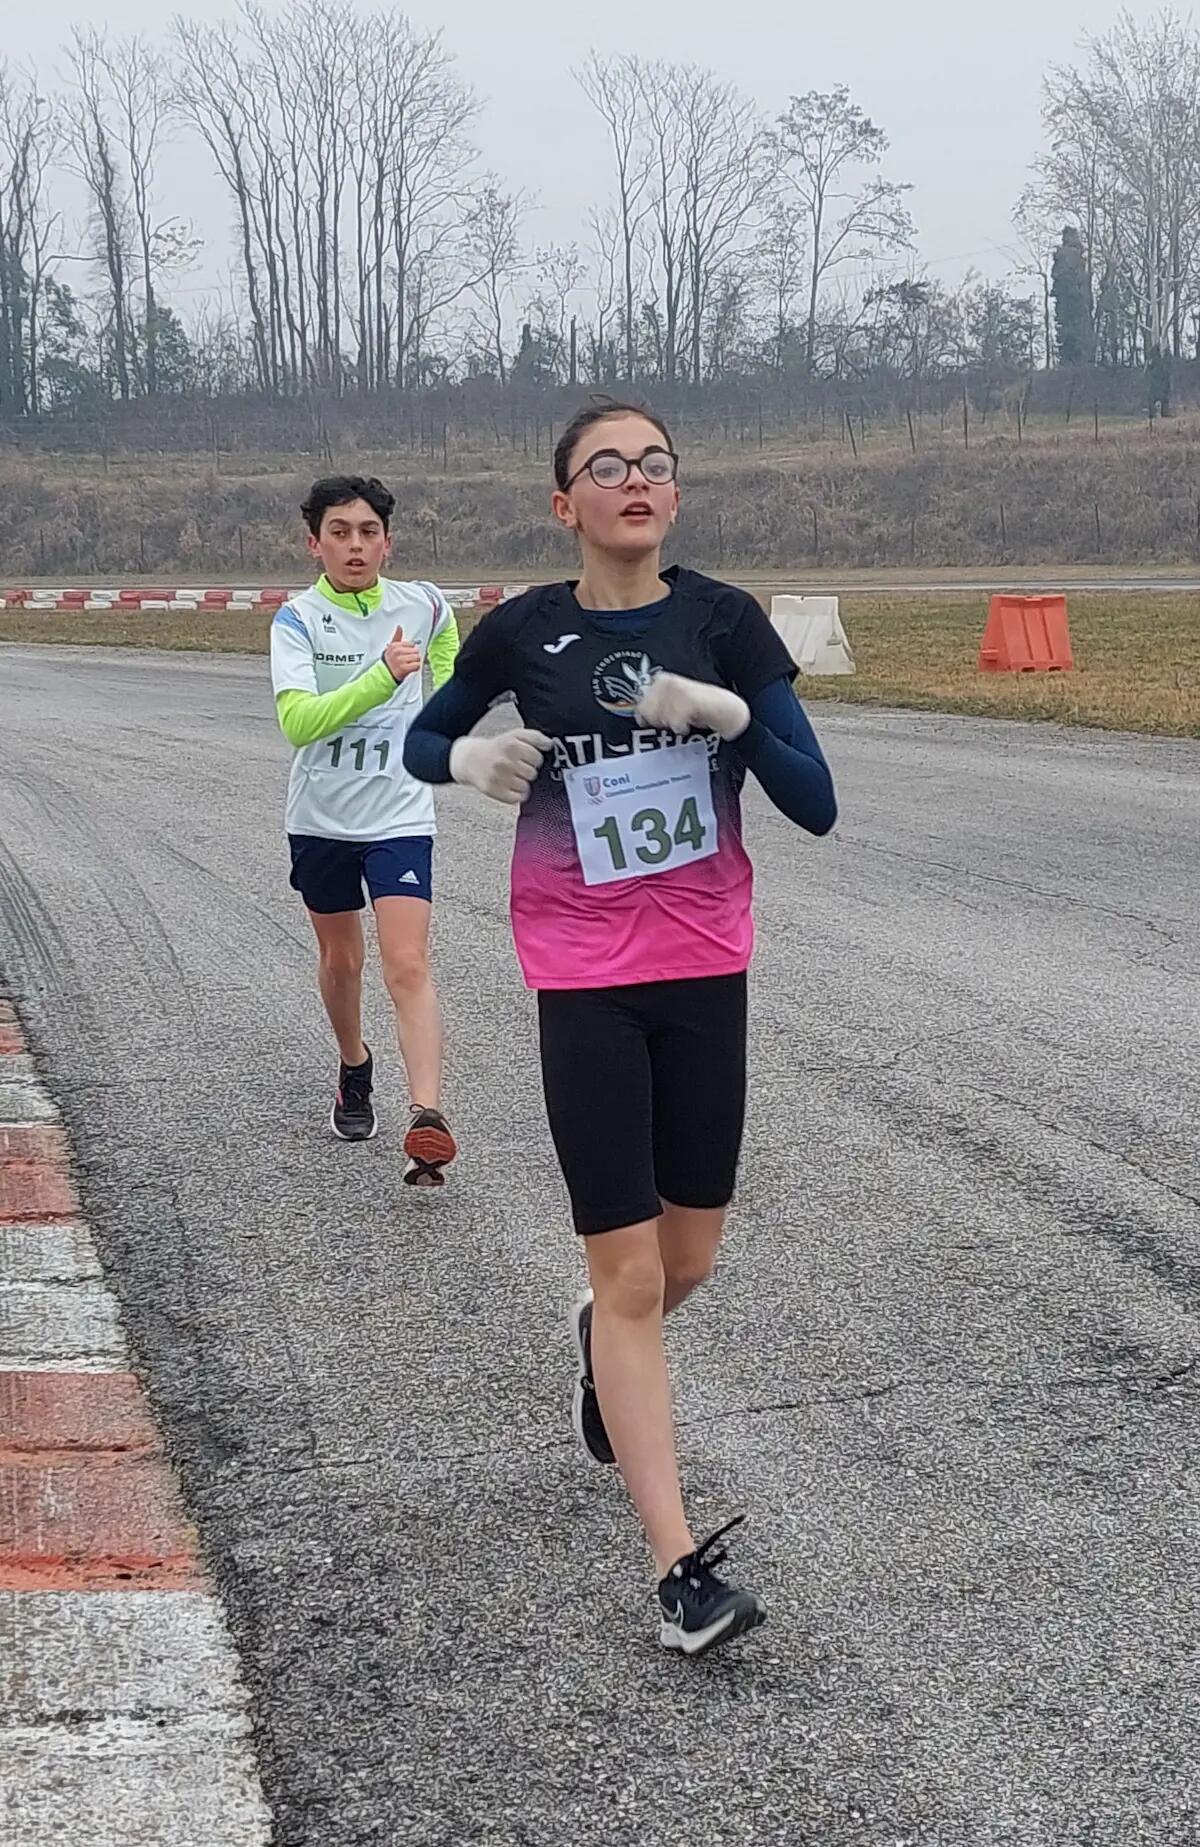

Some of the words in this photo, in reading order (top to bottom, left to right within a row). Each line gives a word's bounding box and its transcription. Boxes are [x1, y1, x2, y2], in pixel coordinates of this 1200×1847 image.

[326, 735, 390, 772] 111
[602, 772, 631, 788] Coni
[592, 795, 707, 871] 134
